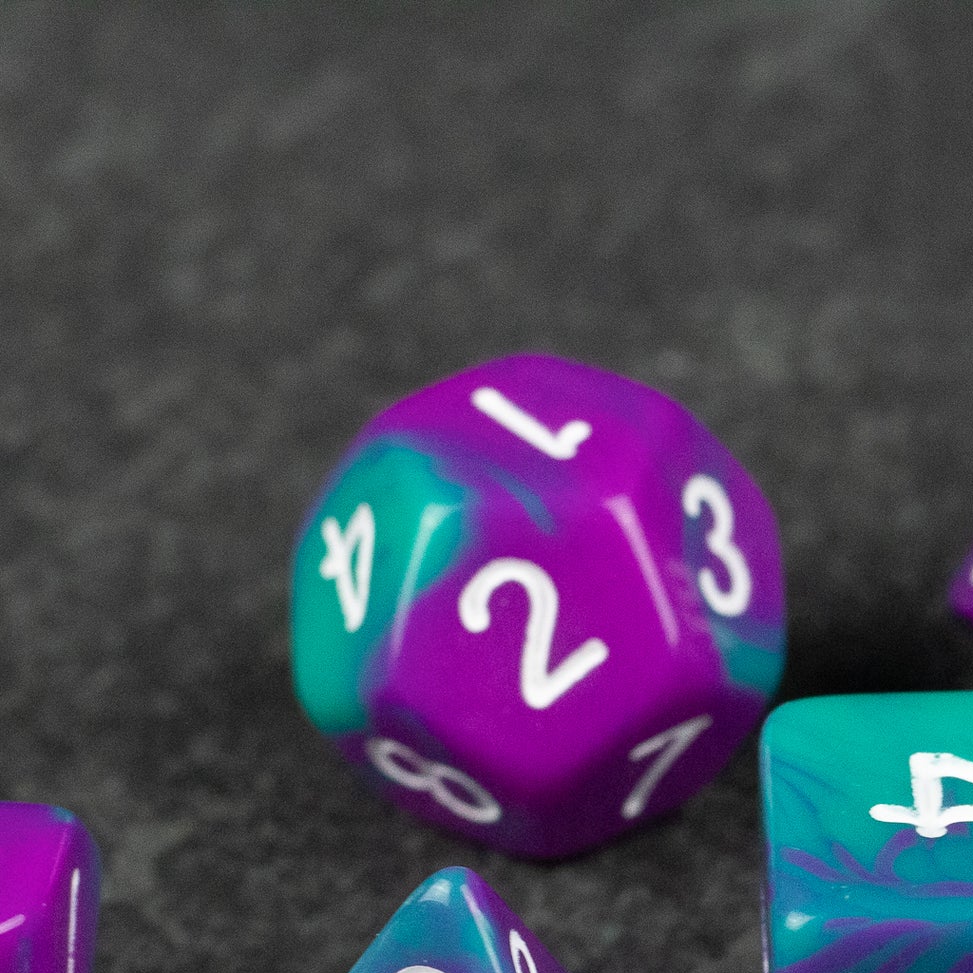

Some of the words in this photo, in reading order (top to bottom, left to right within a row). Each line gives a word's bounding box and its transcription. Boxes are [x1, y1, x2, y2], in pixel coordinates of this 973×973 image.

[471, 387, 592, 460] 1
[319, 502, 377, 633] 4
[681, 474, 753, 618] 3
[457, 556, 610, 710] 2
[365, 737, 501, 824] 8
